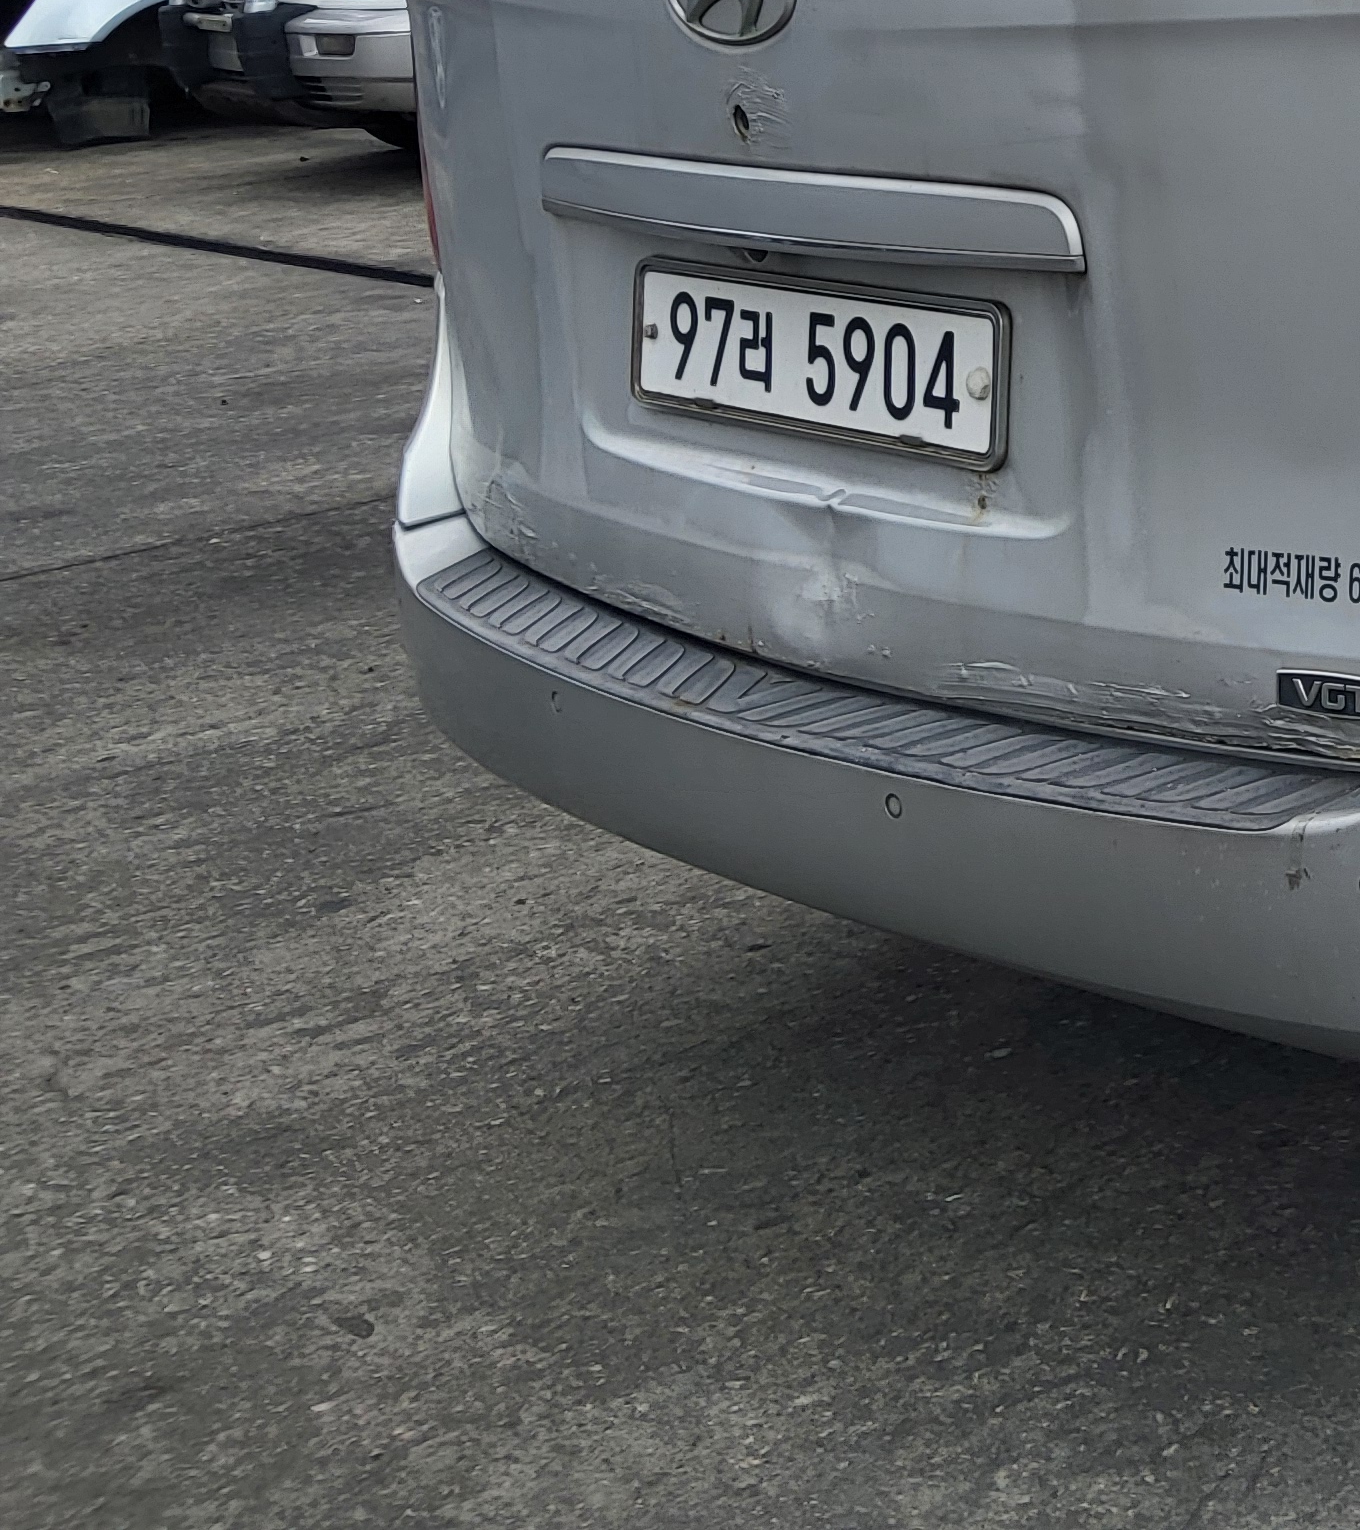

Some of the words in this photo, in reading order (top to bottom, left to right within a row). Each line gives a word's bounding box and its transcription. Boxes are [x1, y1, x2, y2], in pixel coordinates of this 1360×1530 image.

[670, 291, 773, 393] 97러
[806, 311, 960, 430] 5904
[1223, 547, 1342, 603] 최대적재량
